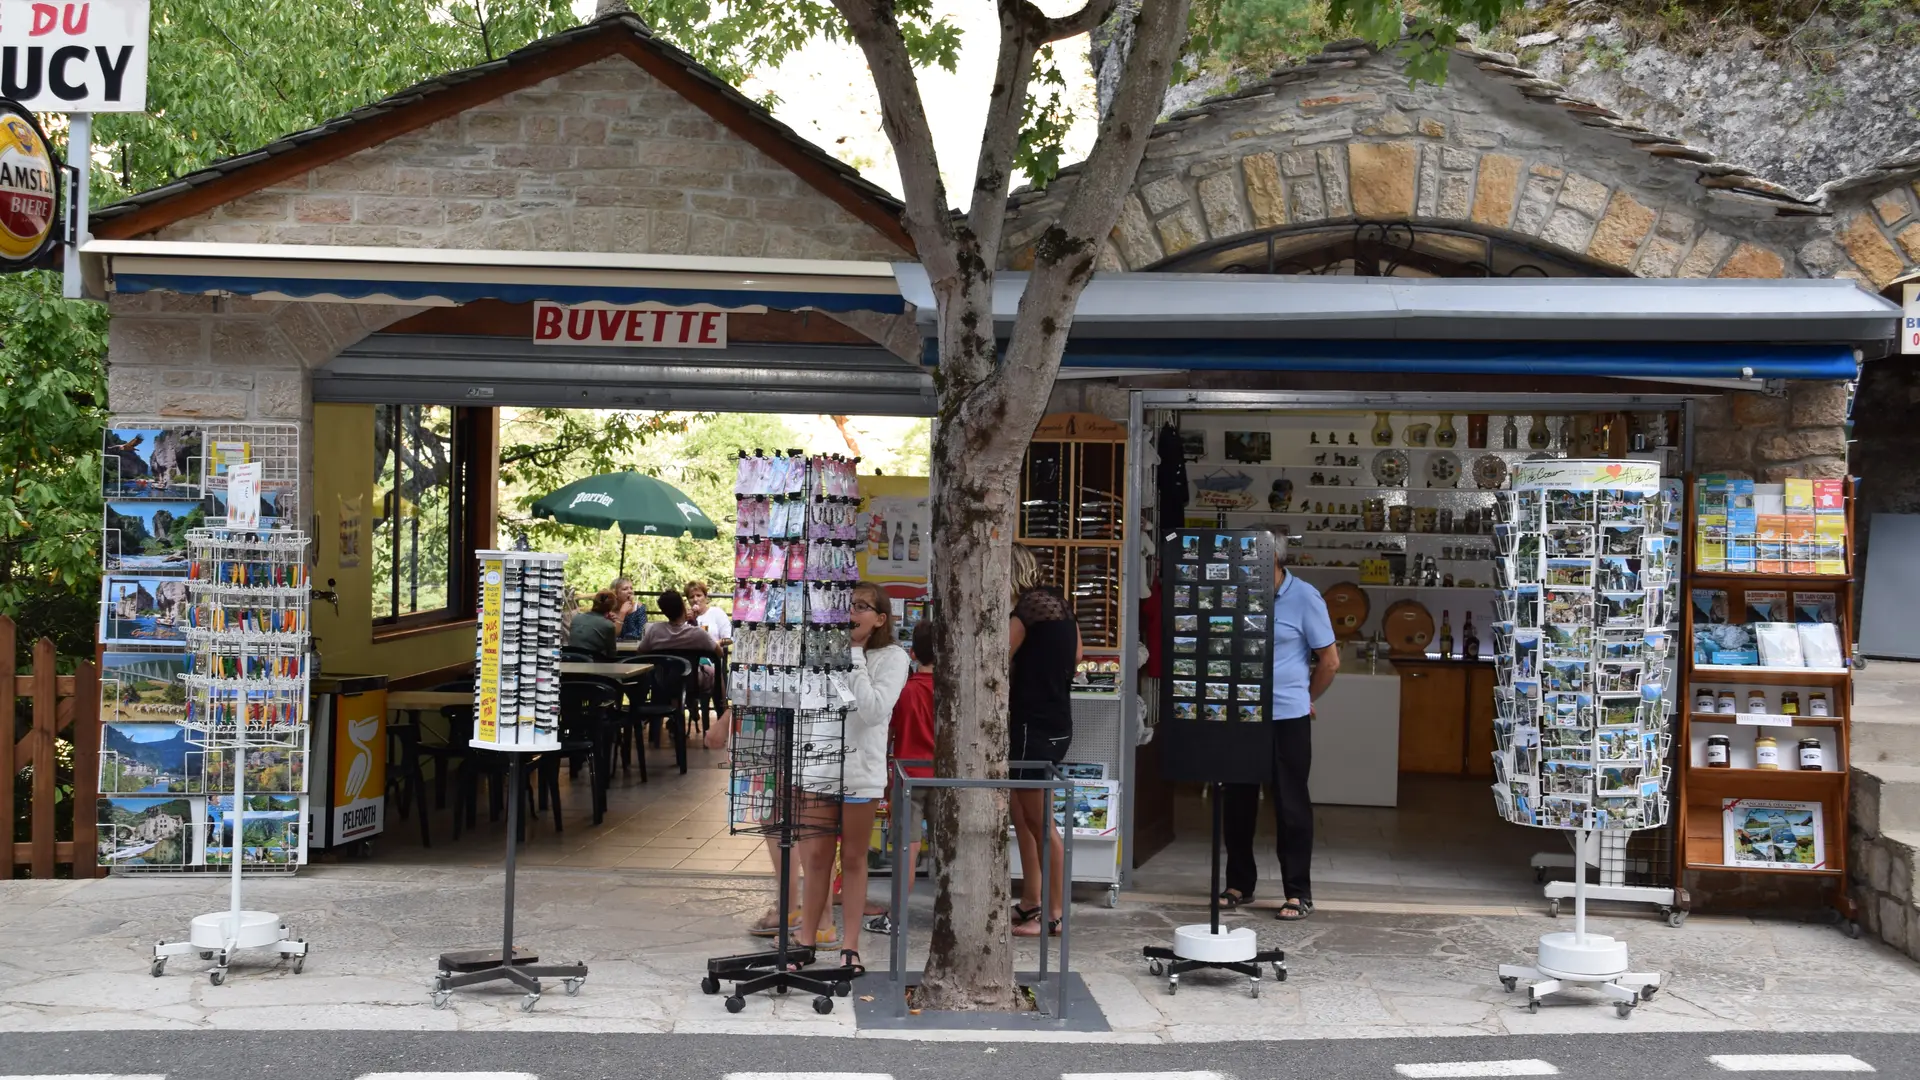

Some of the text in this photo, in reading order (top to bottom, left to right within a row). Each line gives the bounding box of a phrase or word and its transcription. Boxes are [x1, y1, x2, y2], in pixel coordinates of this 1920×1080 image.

[29, 3, 90, 36] DU
[1, 45, 135, 102] UCY
[0, 162, 53, 193] AMSTEL
[11, 196, 48, 216] BIERE
[535, 306, 722, 343] BUVETTE
[343, 805, 376, 831] PELFORTH
